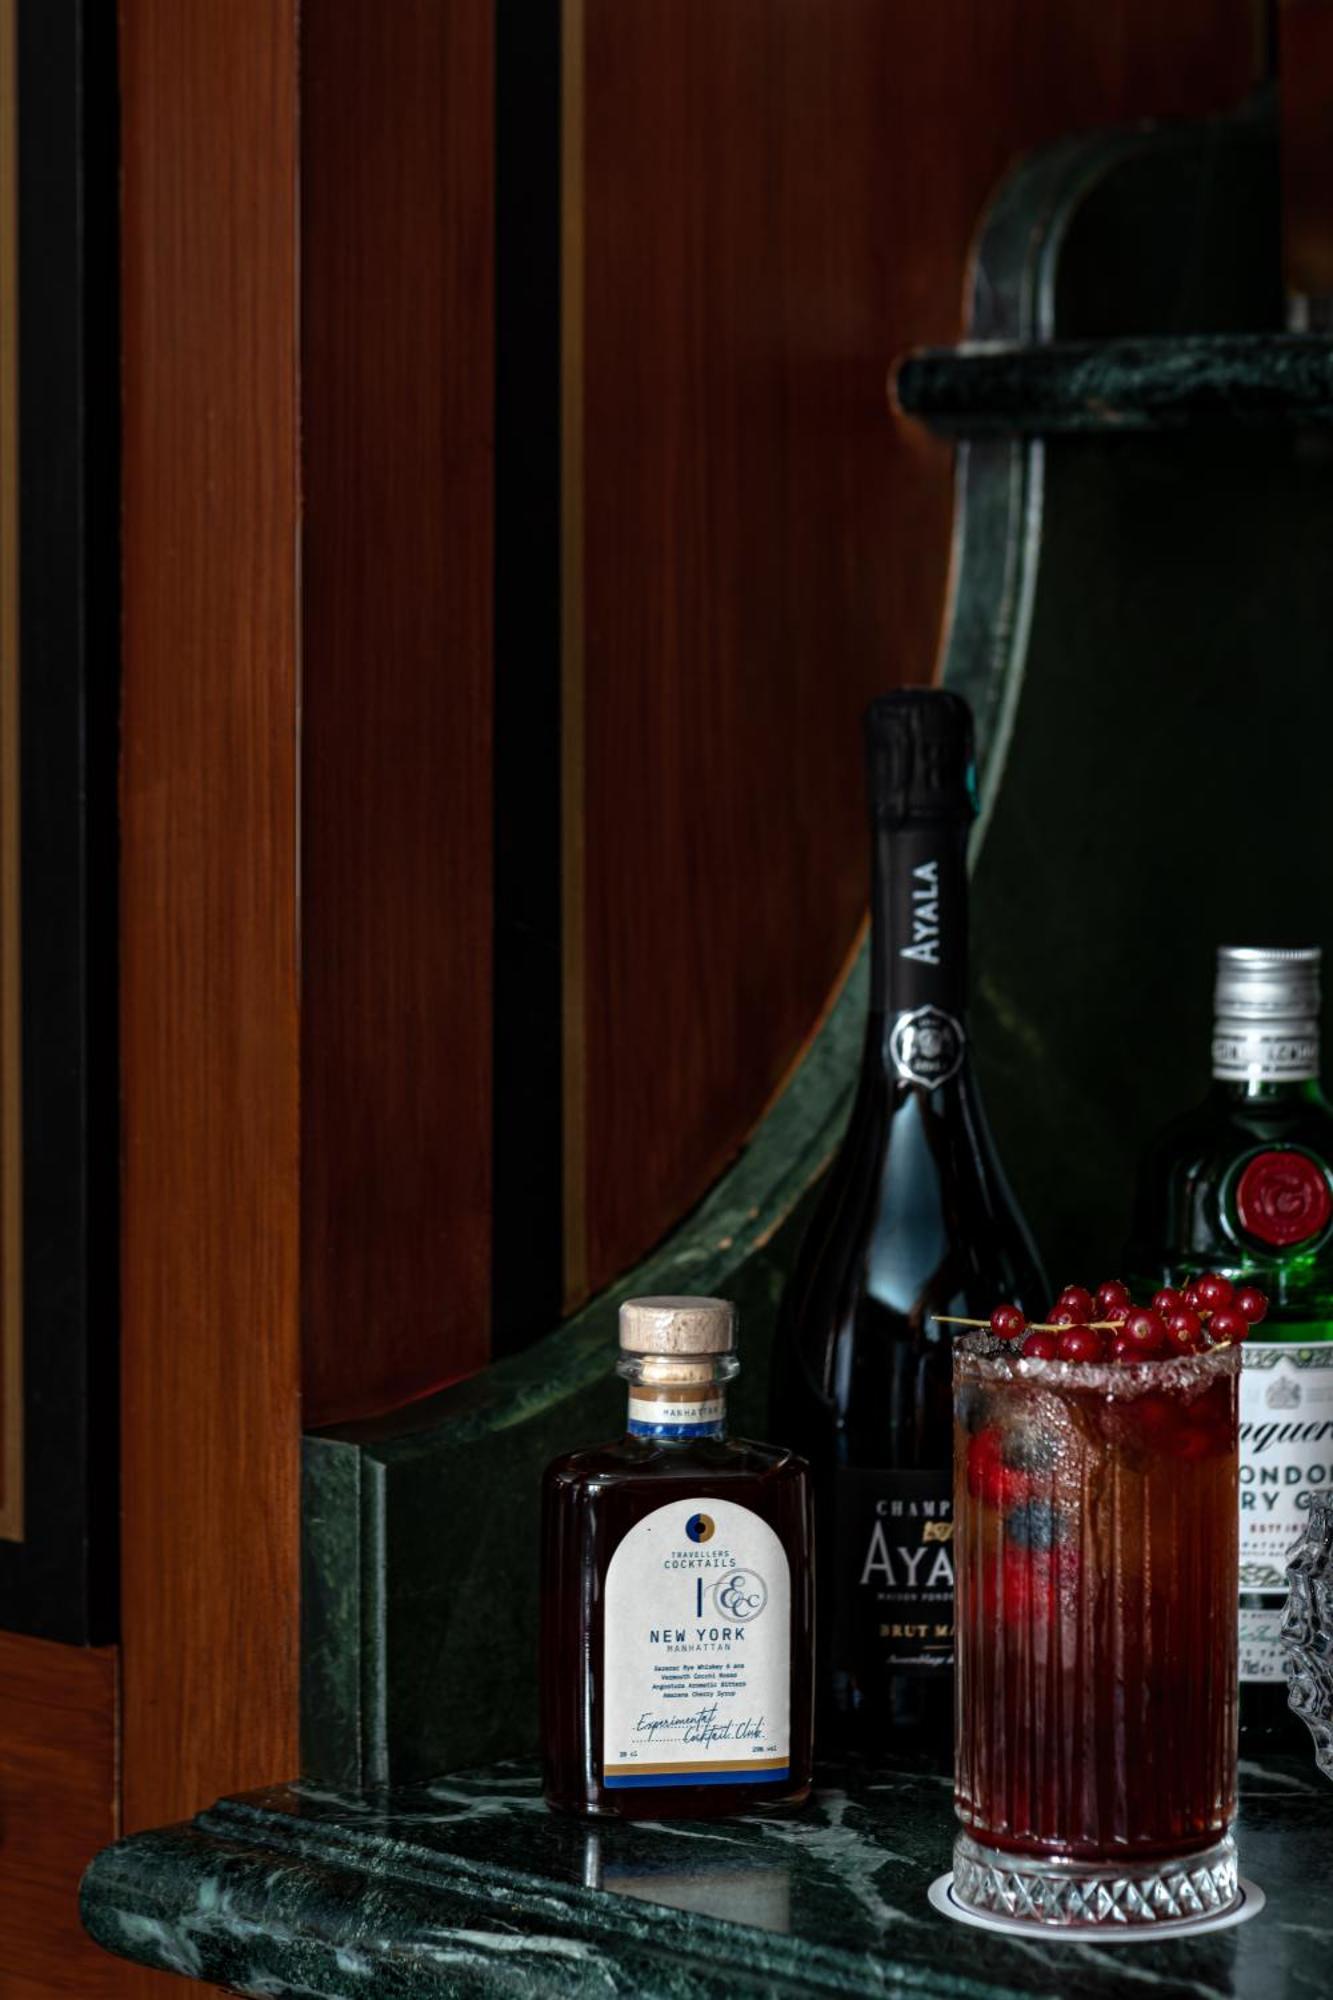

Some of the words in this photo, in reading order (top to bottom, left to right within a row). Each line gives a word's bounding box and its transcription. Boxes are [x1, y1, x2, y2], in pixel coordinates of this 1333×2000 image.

[900, 861, 939, 965] AYALA
[671, 1550, 731, 1559] TRAVELLERS
[664, 1558, 737, 1569] COCKTAILS
[650, 1629, 686, 1643] NEW
[697, 1627, 745, 1641] YORK
[880, 1623, 928, 1638] BRUT
[667, 1643, 731, 1652] MANHATTAN
[636, 1702, 718, 1741] Experimental
